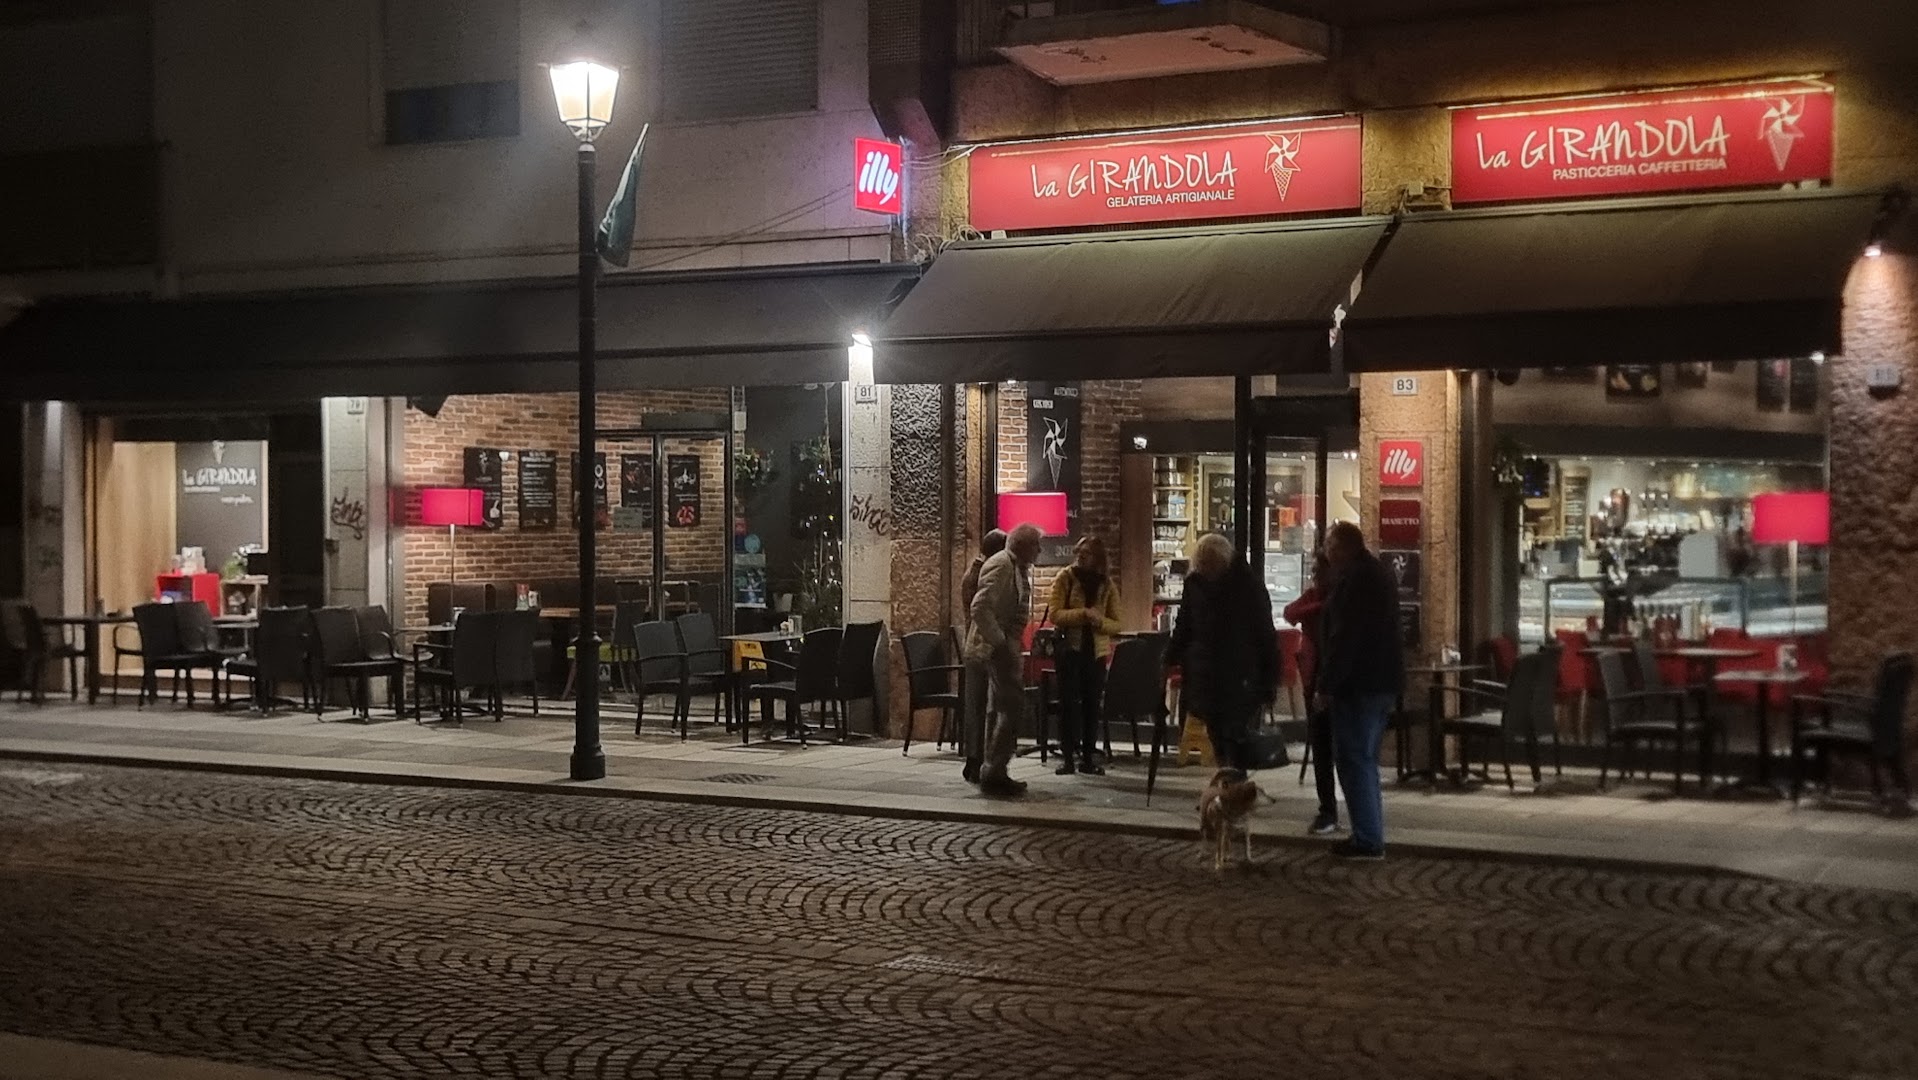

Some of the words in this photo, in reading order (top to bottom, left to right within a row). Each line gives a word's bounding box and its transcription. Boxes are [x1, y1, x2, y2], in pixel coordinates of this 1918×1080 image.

[1476, 132, 1511, 169] La
[1520, 115, 1730, 169] GIRANDOLA
[858, 151, 899, 206] illy
[1031, 164, 1060, 198] La
[1067, 150, 1238, 198] GIRANDOLA
[1552, 163, 1637, 181] PASTICCERIA
[1637, 157, 1728, 175] CAFFETTERIA
[1106, 193, 1163, 208] GELATERIA
[1164, 189, 1235, 205] ARTIGIANALE
[860, 386, 871, 397] 81
[1396, 379, 1414, 391] 83
[1383, 448, 1417, 480] illy
